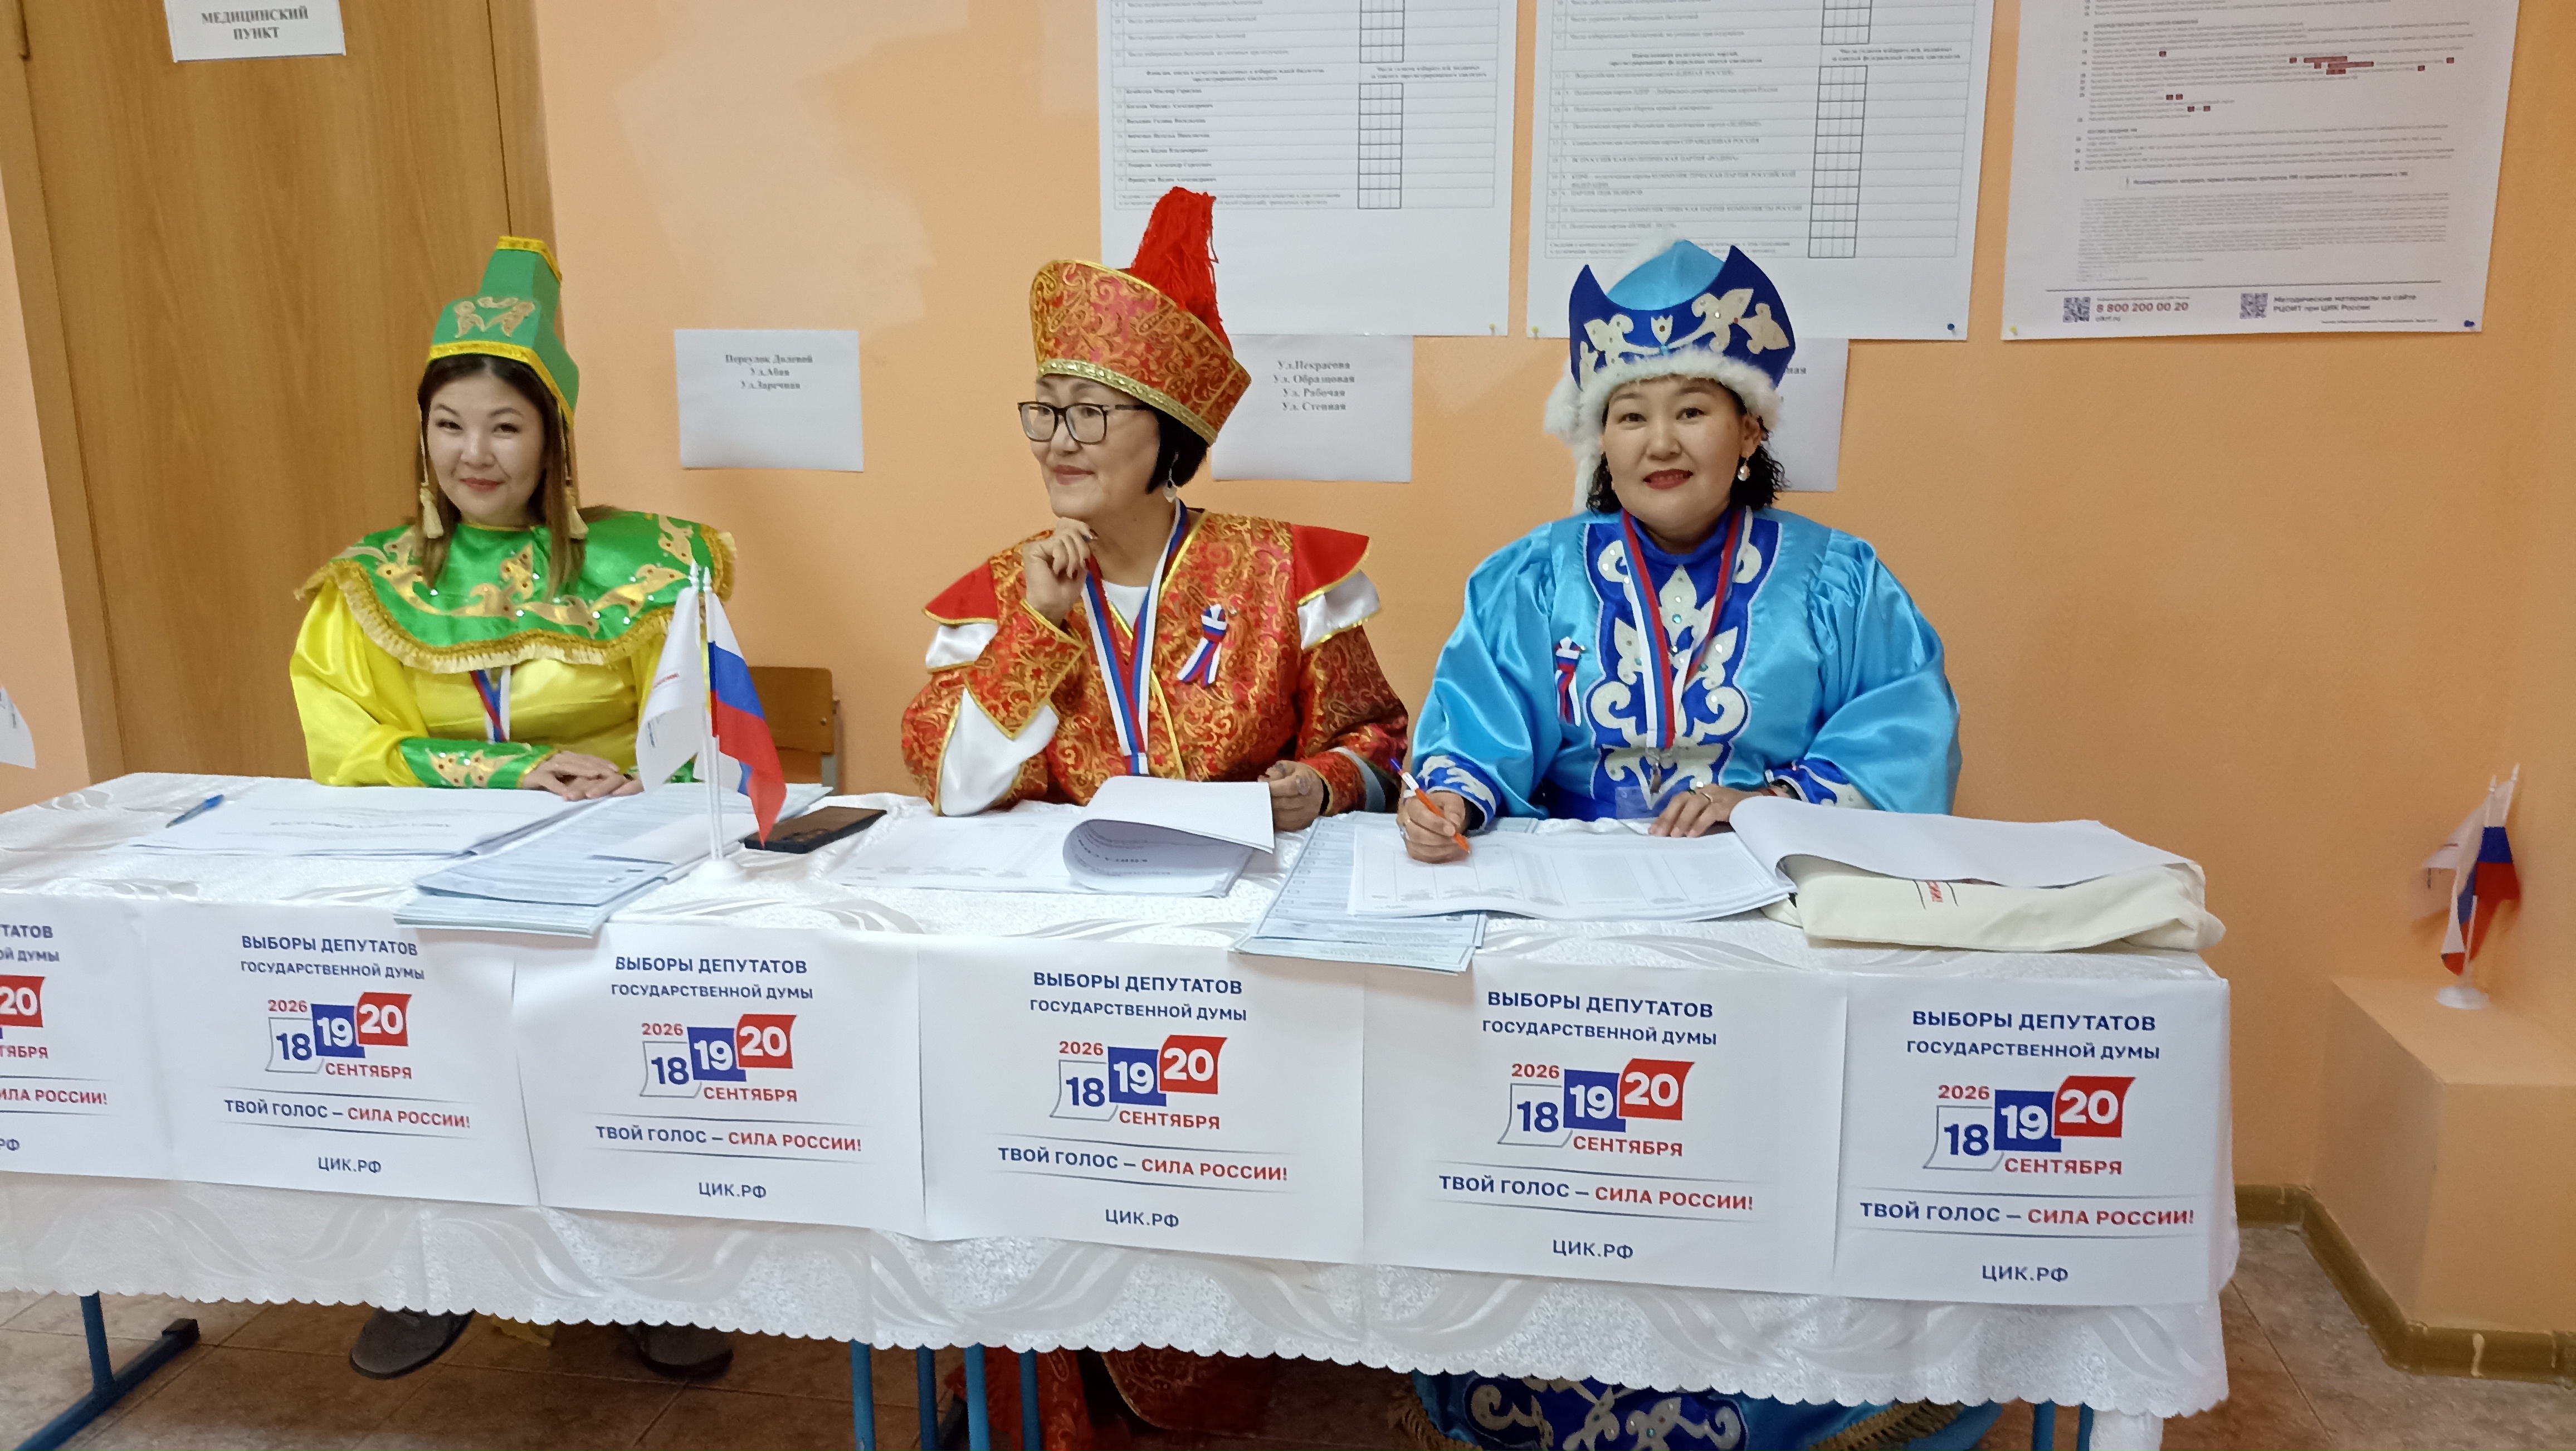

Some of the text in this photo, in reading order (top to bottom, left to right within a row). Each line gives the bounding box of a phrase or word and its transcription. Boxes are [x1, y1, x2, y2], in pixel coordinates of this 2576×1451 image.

[201, 6, 308, 25] МЕДИЦИНСКИЙ
[234, 27, 280, 40] ПУНКТ
[2096, 302, 2188, 313] 8 800 200 00 20
[242, 936, 418, 956] ВЫБОРЫ ДЕПУТАТОВ
[18, 950, 60, 963] ДУМЫ
[616, 956, 807, 974] ВЫБОРЫ ДЕПУТАТОВ
[241, 961, 425, 980] ГОСУДАРСТВЕННОЙ ДУМЫ
[612, 983, 813, 1000] ГОСУДАРСТВЕННОЙ ДУМЫ
[1034, 972, 1242, 994] ВЫБОРЫ ДЕПУТАТОВ
[0, 986, 37, 1016] 20
[268, 1000, 308, 1012] 2026
[1030, 1000, 1246, 1021] ГОСУДАРСТВЕННОЙ ДУМЫ
[1488, 991, 1713, 1017] ВЫБОРЫ ДЕПУТАТОВ
[642, 1023, 683, 1036] 2026
[1913, 1011, 2155, 1031] ВЫБОРЫ ДЕПУТАТОВ
[276, 1004, 403, 1060] 18 19 20
[1483, 1020, 1716, 1045] ГОСУДАРСТВЕННОЙ ДУМЫ
[651, 1026, 786, 1085] 18 19 20
[1059, 1041, 1104, 1055] 2026
[1907, 1041, 2159, 1060] ГОСУДАРСТВЕННОЙ ДУМЫ
[325, 1063, 412, 1079] СЕНТЯБРЯ
[1066, 1048, 1214, 1107] 18 19 20
[1511, 1063, 1559, 1078] 2026
[35, 1089, 108, 1106] РОССИИ!
[704, 1087, 797, 1102] СЕНТЯБРЯ
[1517, 1071, 1679, 1132] 18 19 20
[1938, 1084, 1989, 1100] 2026
[225, 1098, 268, 1114] ТВОЙ
[272, 1103, 327, 1118] ГОЛОС
[348, 1108, 393, 1122] СИЛА
[398, 1112, 470, 1128] РОССИИ!
[1119, 1111, 1220, 1129] СЕНТЯБРЯ
[1944, 1089, 2118, 1156] 18 19 20
[596, 1125, 642, 1141] ТВОЙ
[648, 1129, 706, 1143] ГОЛОС
[729, 1132, 777, 1146] СИЛА
[783, 1134, 861, 1151] РОССИИ!
[1573, 1136, 1682, 1157] СЕНТЯБРЯ
[318, 1156, 381, 1173] ЦИК.РФ
[998, 1147, 1049, 1163] ТВОЙ
[1056, 1152, 1118, 1169] ГОЛОС
[1141, 1158, 1193, 1175] СИЛА
[1200, 1163, 1286, 1180] РОССИИ!
[2004, 1158, 2121, 1175] СЕНТЯБРЯ
[699, 1182, 767, 1199] ЦИК.РФ
[1439, 1175, 1494, 1193] ТВОЙ
[1501, 1180, 1568, 1197] ГОЛОС
[1596, 1187, 1651, 1204] СИЛА
[1659, 1191, 1753, 1210] РОССИИ!
[1106, 1209, 1178, 1227] ЦИК.РФ
[1860, 1201, 1919, 1219] ТВОЙ
[1926, 1206, 2000, 1221] ГОЛОС
[2028, 1209, 2089, 1225] СИЛА
[2097, 1210, 2194, 1225] РОССИИ!
[1553, 1239, 1633, 1259] ЦИК.РФ
[1982, 1265, 2068, 1282] ЦИК.РФ
